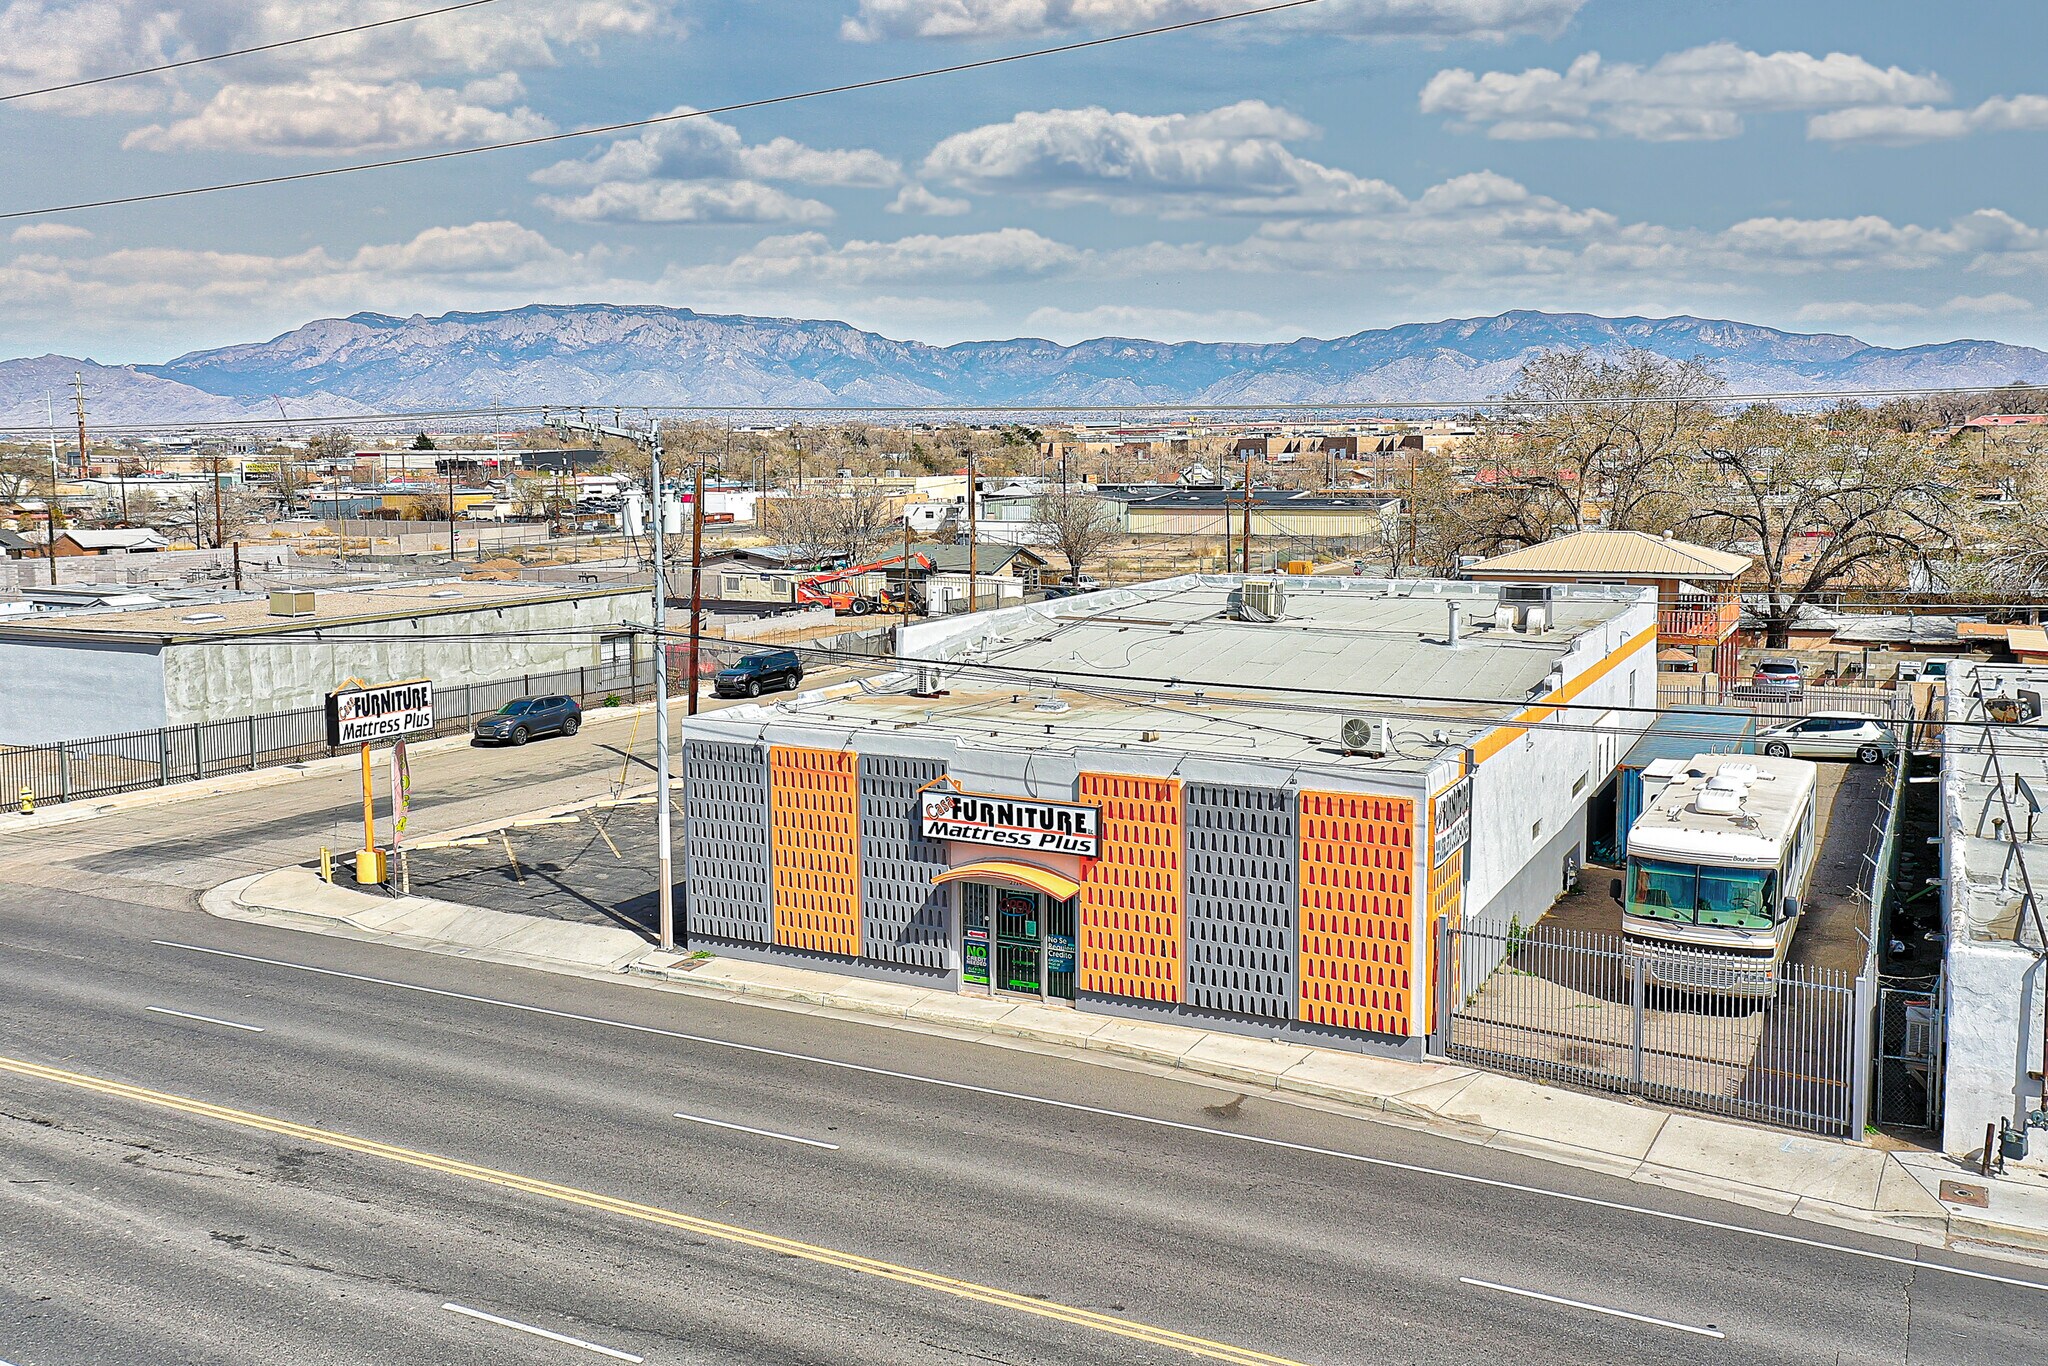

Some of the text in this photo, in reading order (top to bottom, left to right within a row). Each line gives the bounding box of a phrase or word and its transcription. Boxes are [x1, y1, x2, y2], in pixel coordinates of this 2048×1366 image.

[354, 687, 428, 717] FURNITURE
[342, 712, 430, 741] Mattress Plus
[925, 795, 955, 821] Casa
[952, 797, 1088, 836] FURNITURE
[927, 821, 1092, 853] Mattress Plus
[998, 898, 1031, 914] OPEN
[966, 945, 987, 958] NO
[1048, 936, 1067, 945] No Se
